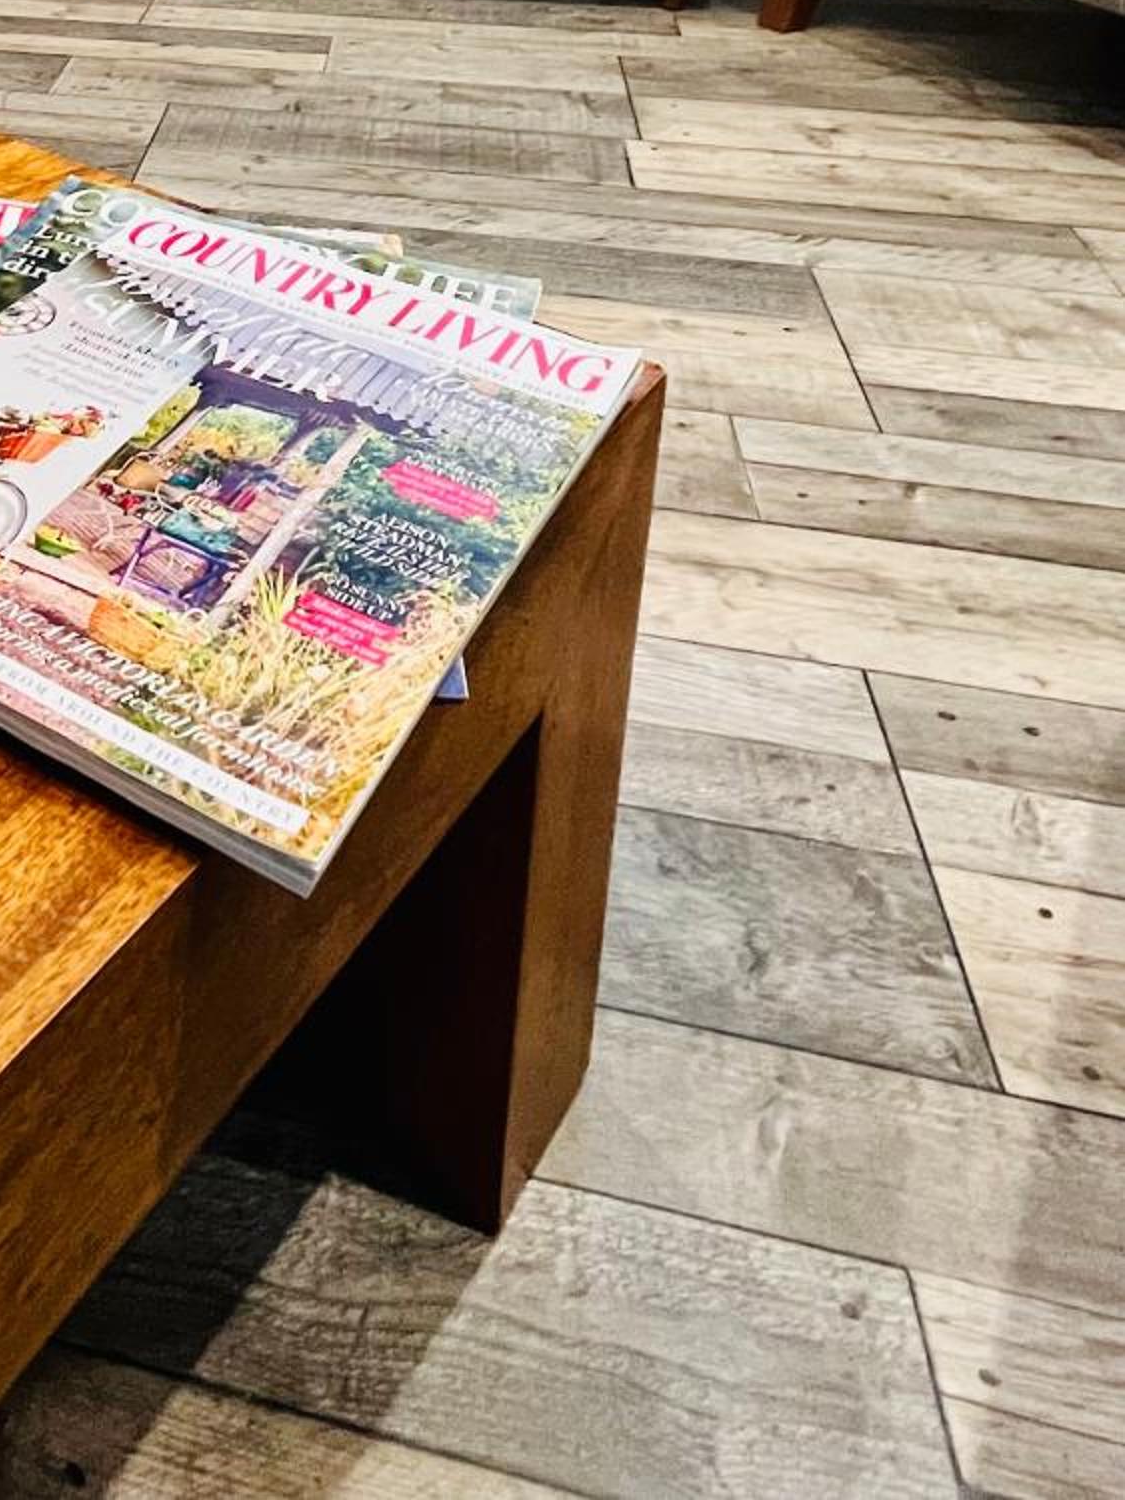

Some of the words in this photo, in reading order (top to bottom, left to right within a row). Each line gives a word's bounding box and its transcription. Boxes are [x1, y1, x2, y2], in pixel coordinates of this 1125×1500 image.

[128, 219, 391, 317] COUNTRY
[388, 296, 613, 395] LIVING
[83, 291, 344, 403] SUMMER
[327, 520, 419, 565] REVEALS
[335, 537, 397, 570] WILD
[344, 513, 465, 569] STEADMAN
[373, 511, 453, 549] ALISON
[321, 585, 368, 612] SIDE
[362, 603, 395, 624] UP
[346, 583, 412, 618] SUNNY
[49, 625, 218, 724] VICTORIAN
[207, 702, 345, 787] GARDEN
[67, 661, 190, 735] medieval
[172, 715, 328, 815] farmhouse
